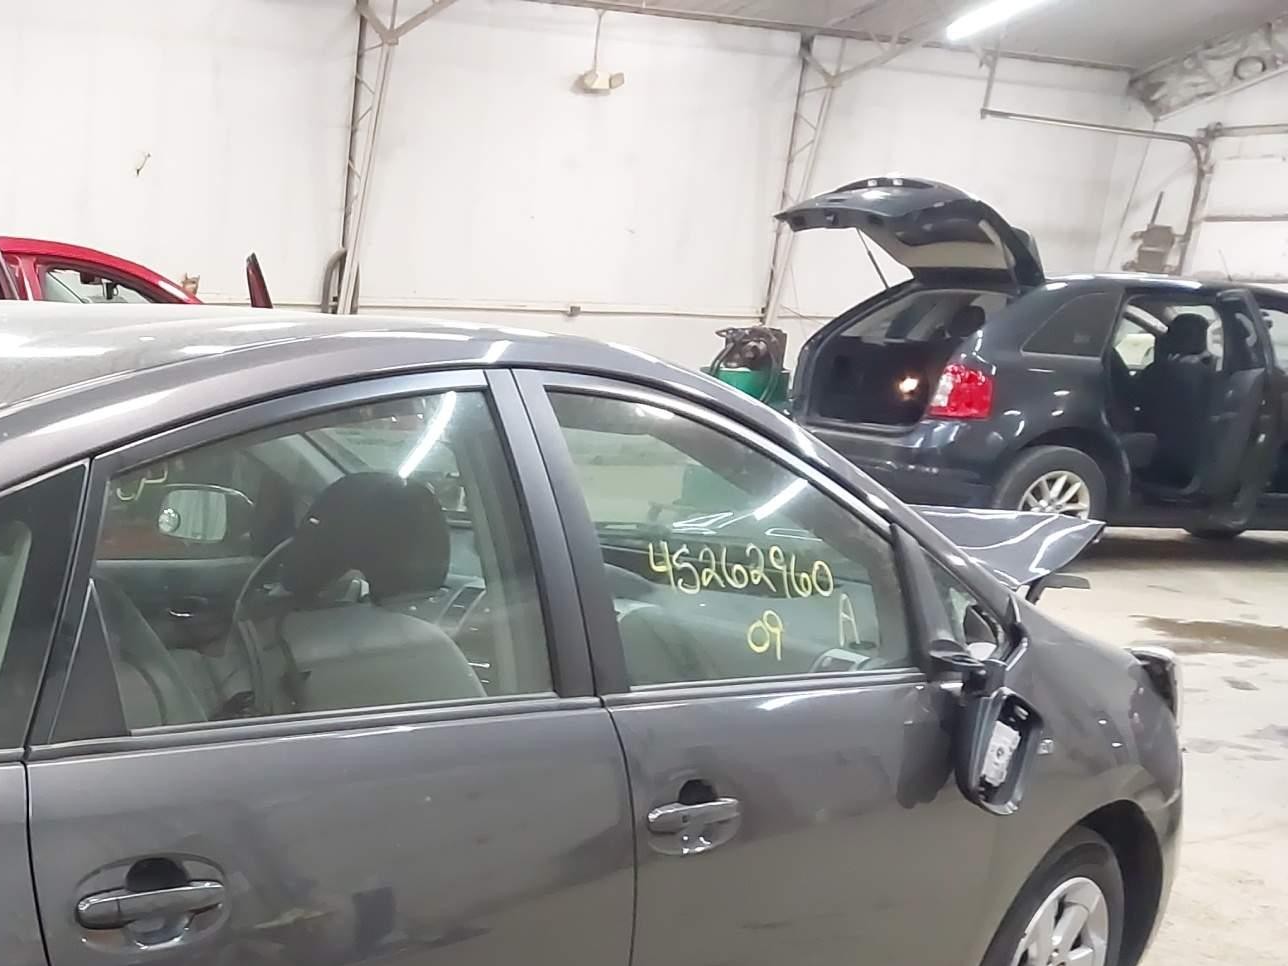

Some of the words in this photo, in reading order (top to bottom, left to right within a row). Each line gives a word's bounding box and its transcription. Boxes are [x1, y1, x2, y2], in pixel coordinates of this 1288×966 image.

[648, 541, 834, 598] 45262960
[747, 610, 783, 661] 09
[839, 593, 861, 646] A
